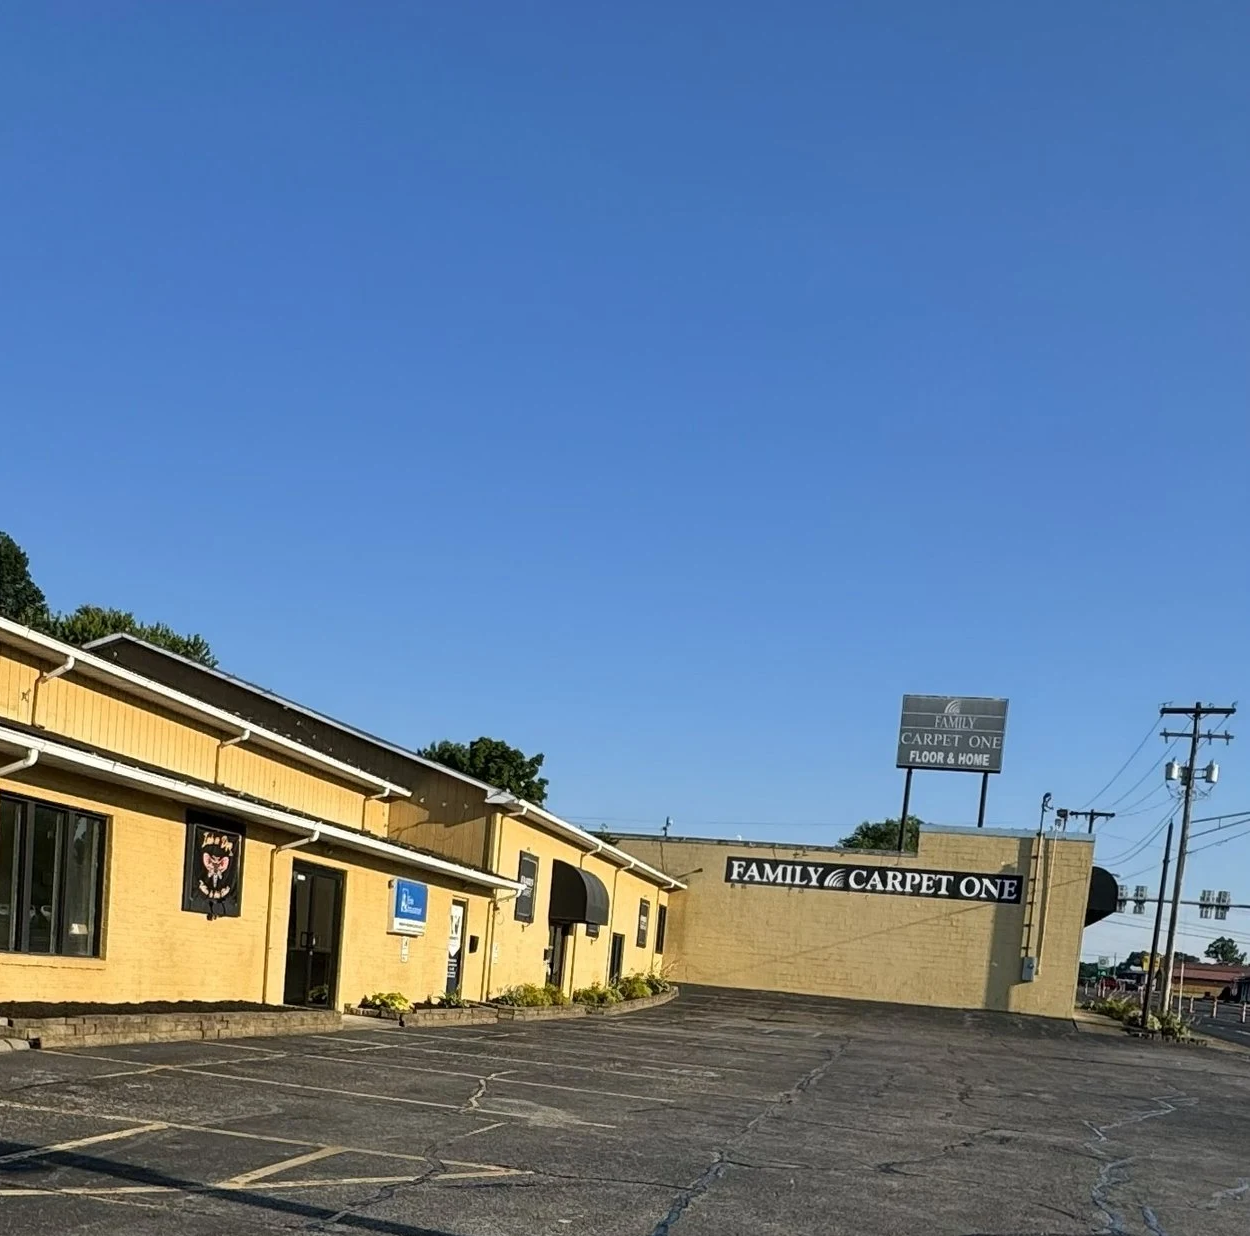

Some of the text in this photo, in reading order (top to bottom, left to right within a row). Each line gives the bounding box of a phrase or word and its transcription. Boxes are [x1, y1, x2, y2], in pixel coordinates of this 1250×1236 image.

[934, 715, 977, 730] FAMILY
[901, 732, 1002, 749] CARPET ONE
[910, 750, 990, 766] FLOOR & HOME
[730, 860, 1018, 900] FAMILY CARPET ONE
